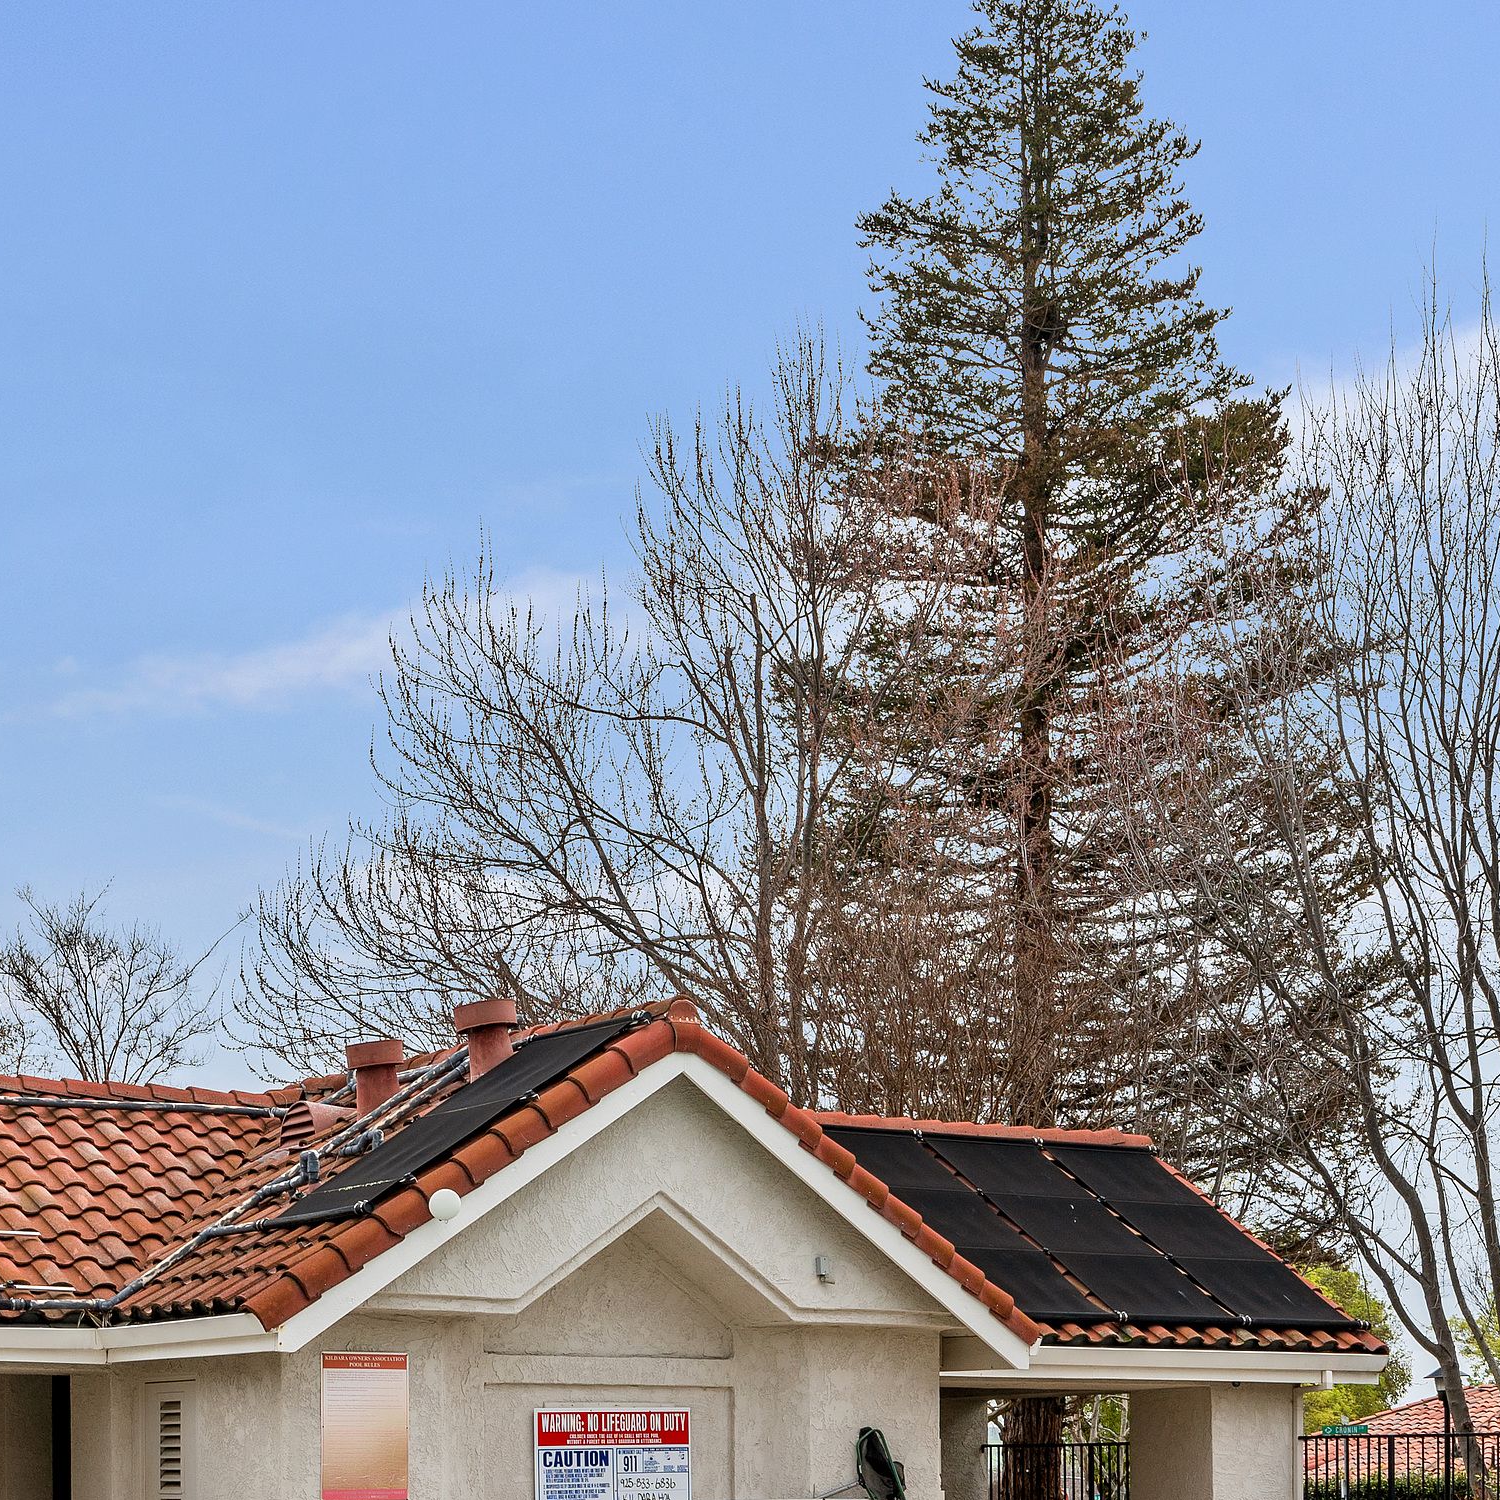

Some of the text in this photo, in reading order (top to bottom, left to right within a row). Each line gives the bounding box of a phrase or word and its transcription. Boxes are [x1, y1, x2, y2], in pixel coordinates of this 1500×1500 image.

[541, 1413, 686, 1433] WARNING: NO LIFEGUARD ON DUTY
[1335, 1426, 1358, 1434] CRONIN
[542, 1450, 609, 1468] CAUTION
[623, 1455, 638, 1472] 911
